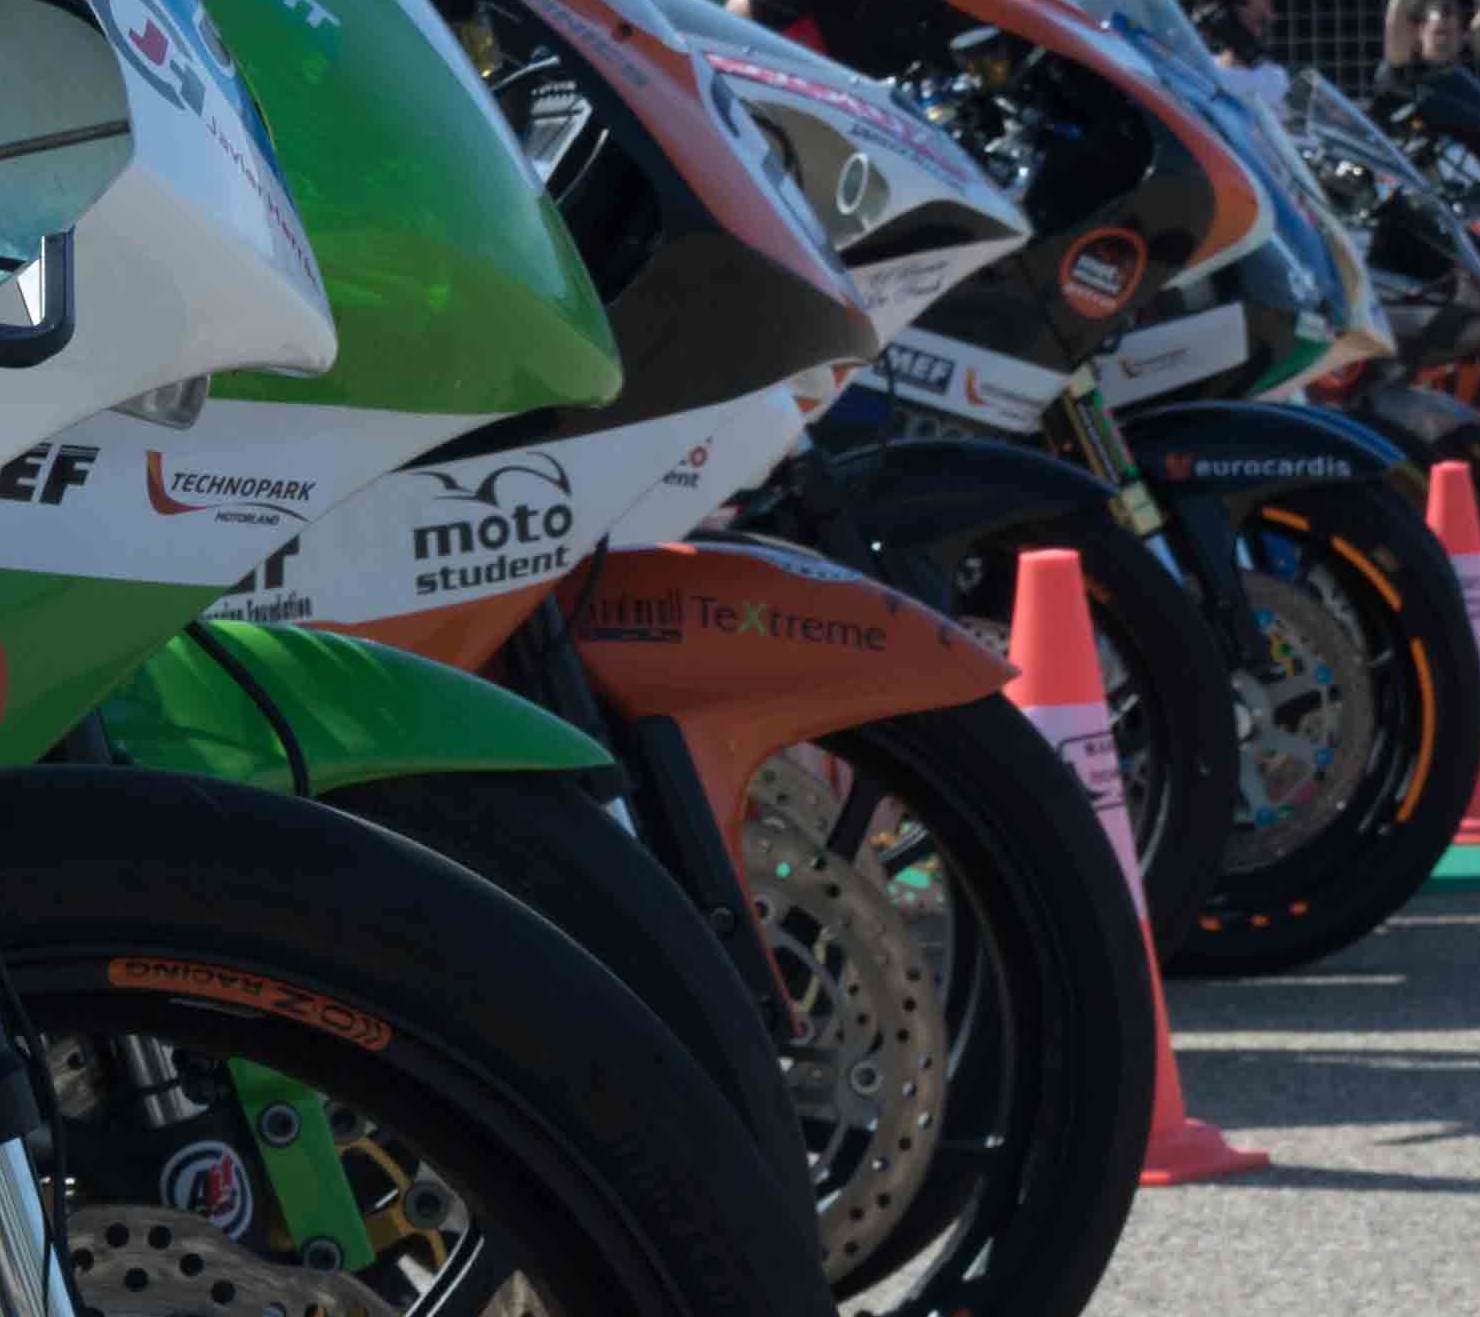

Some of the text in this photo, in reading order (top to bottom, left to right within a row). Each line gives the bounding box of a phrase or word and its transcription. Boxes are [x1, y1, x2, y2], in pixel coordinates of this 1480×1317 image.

[171, 472, 317, 501] TECHNOPARK
[413, 494, 573, 560] moto
[414, 545, 570, 595] student
